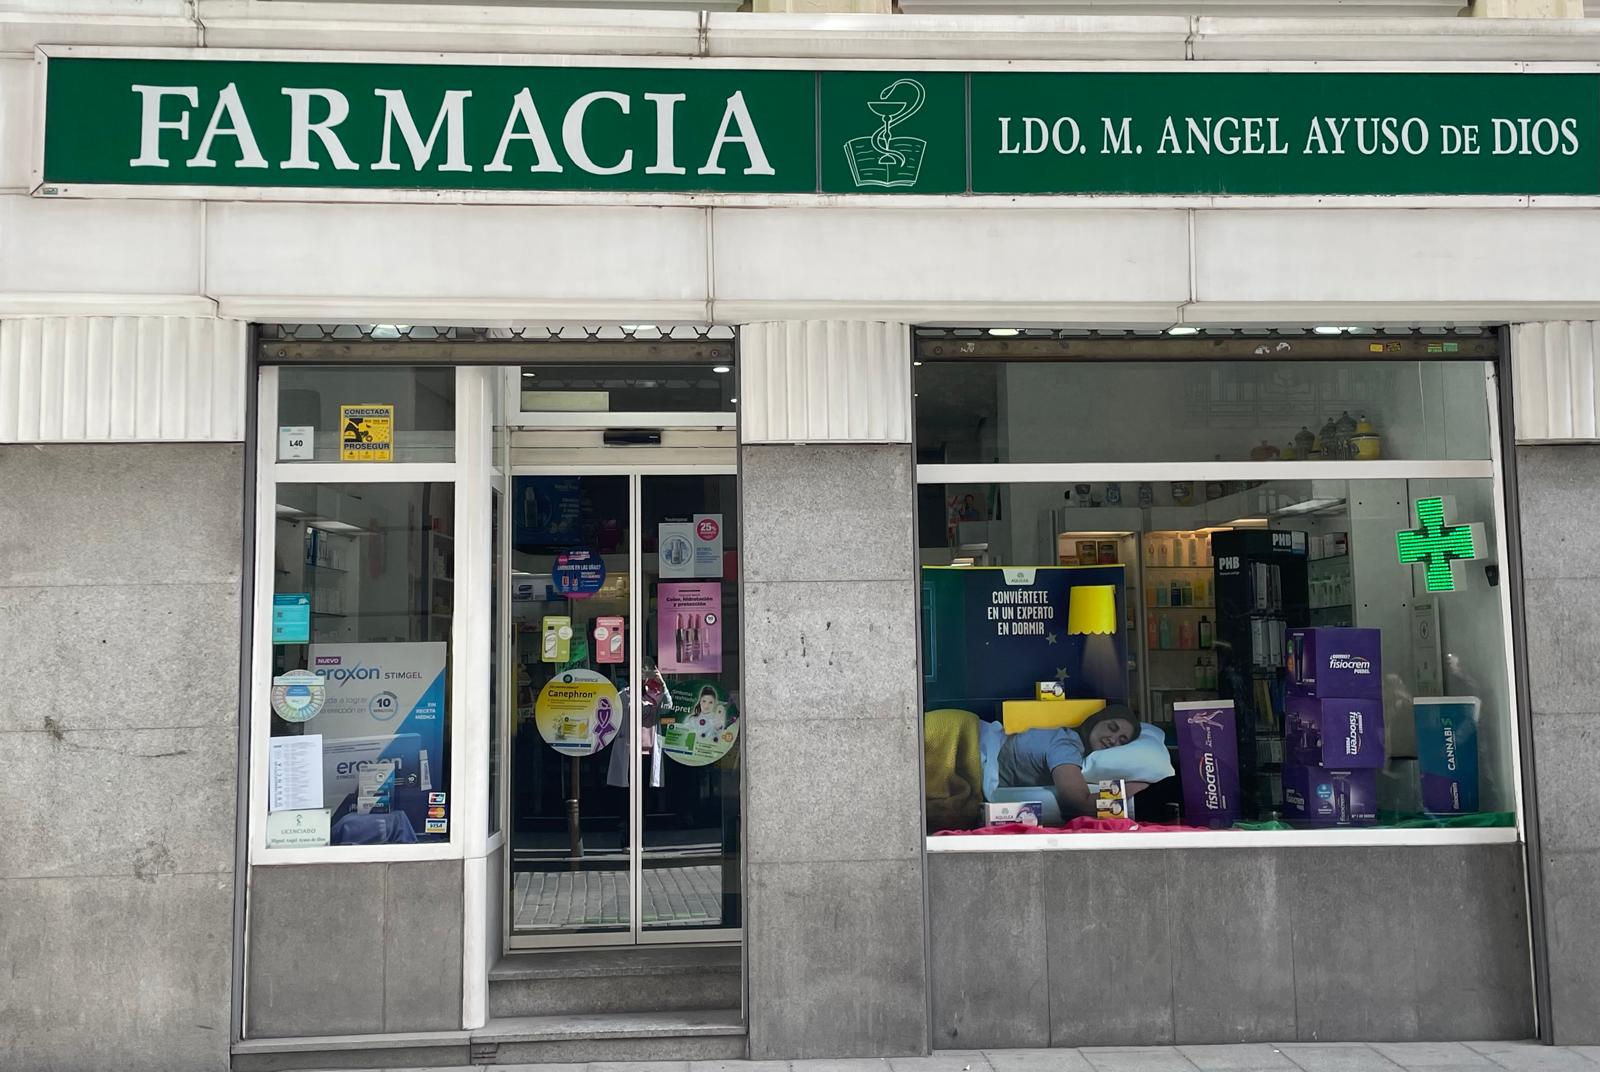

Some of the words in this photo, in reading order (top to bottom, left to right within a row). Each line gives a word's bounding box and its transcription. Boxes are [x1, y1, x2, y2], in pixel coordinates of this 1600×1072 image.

[129, 82, 776, 176] FARMACIA
[998, 117, 1086, 155] LDO.
[1100, 117, 1143, 155] M.
[1156, 115, 1289, 155] ANGEL
[1303, 116, 1429, 155] AYUSO
[1440, 125, 1481, 155] DE
[1491, 118, 1579, 156] DIOS
[289, 439, 304, 447] L40
[1272, 533, 1292, 546] PHB
[1218, 556, 1240, 570] PHB
[992, 589, 1049, 606] CONVIÉRTETE
[987, 606, 999, 620] EN
[1002, 606, 1014, 620] UN
[1017, 605, 1054, 620] EXPERTO
[997, 622, 1009, 636] EN
[1012, 621, 1045, 635] DORMIR
[1329, 658, 1371, 669] fisiocrem
[315, 663, 380, 686] eroxon
[384, 672, 423, 680] STIMGEL
[548, 689, 593, 699] Canephron
[376, 698, 391, 708] 10
[1349, 711, 1358, 755] fisiocrem
[1204, 752, 1218, 810] fisiocrem
[281, 827, 317, 835] LICENCIADO
